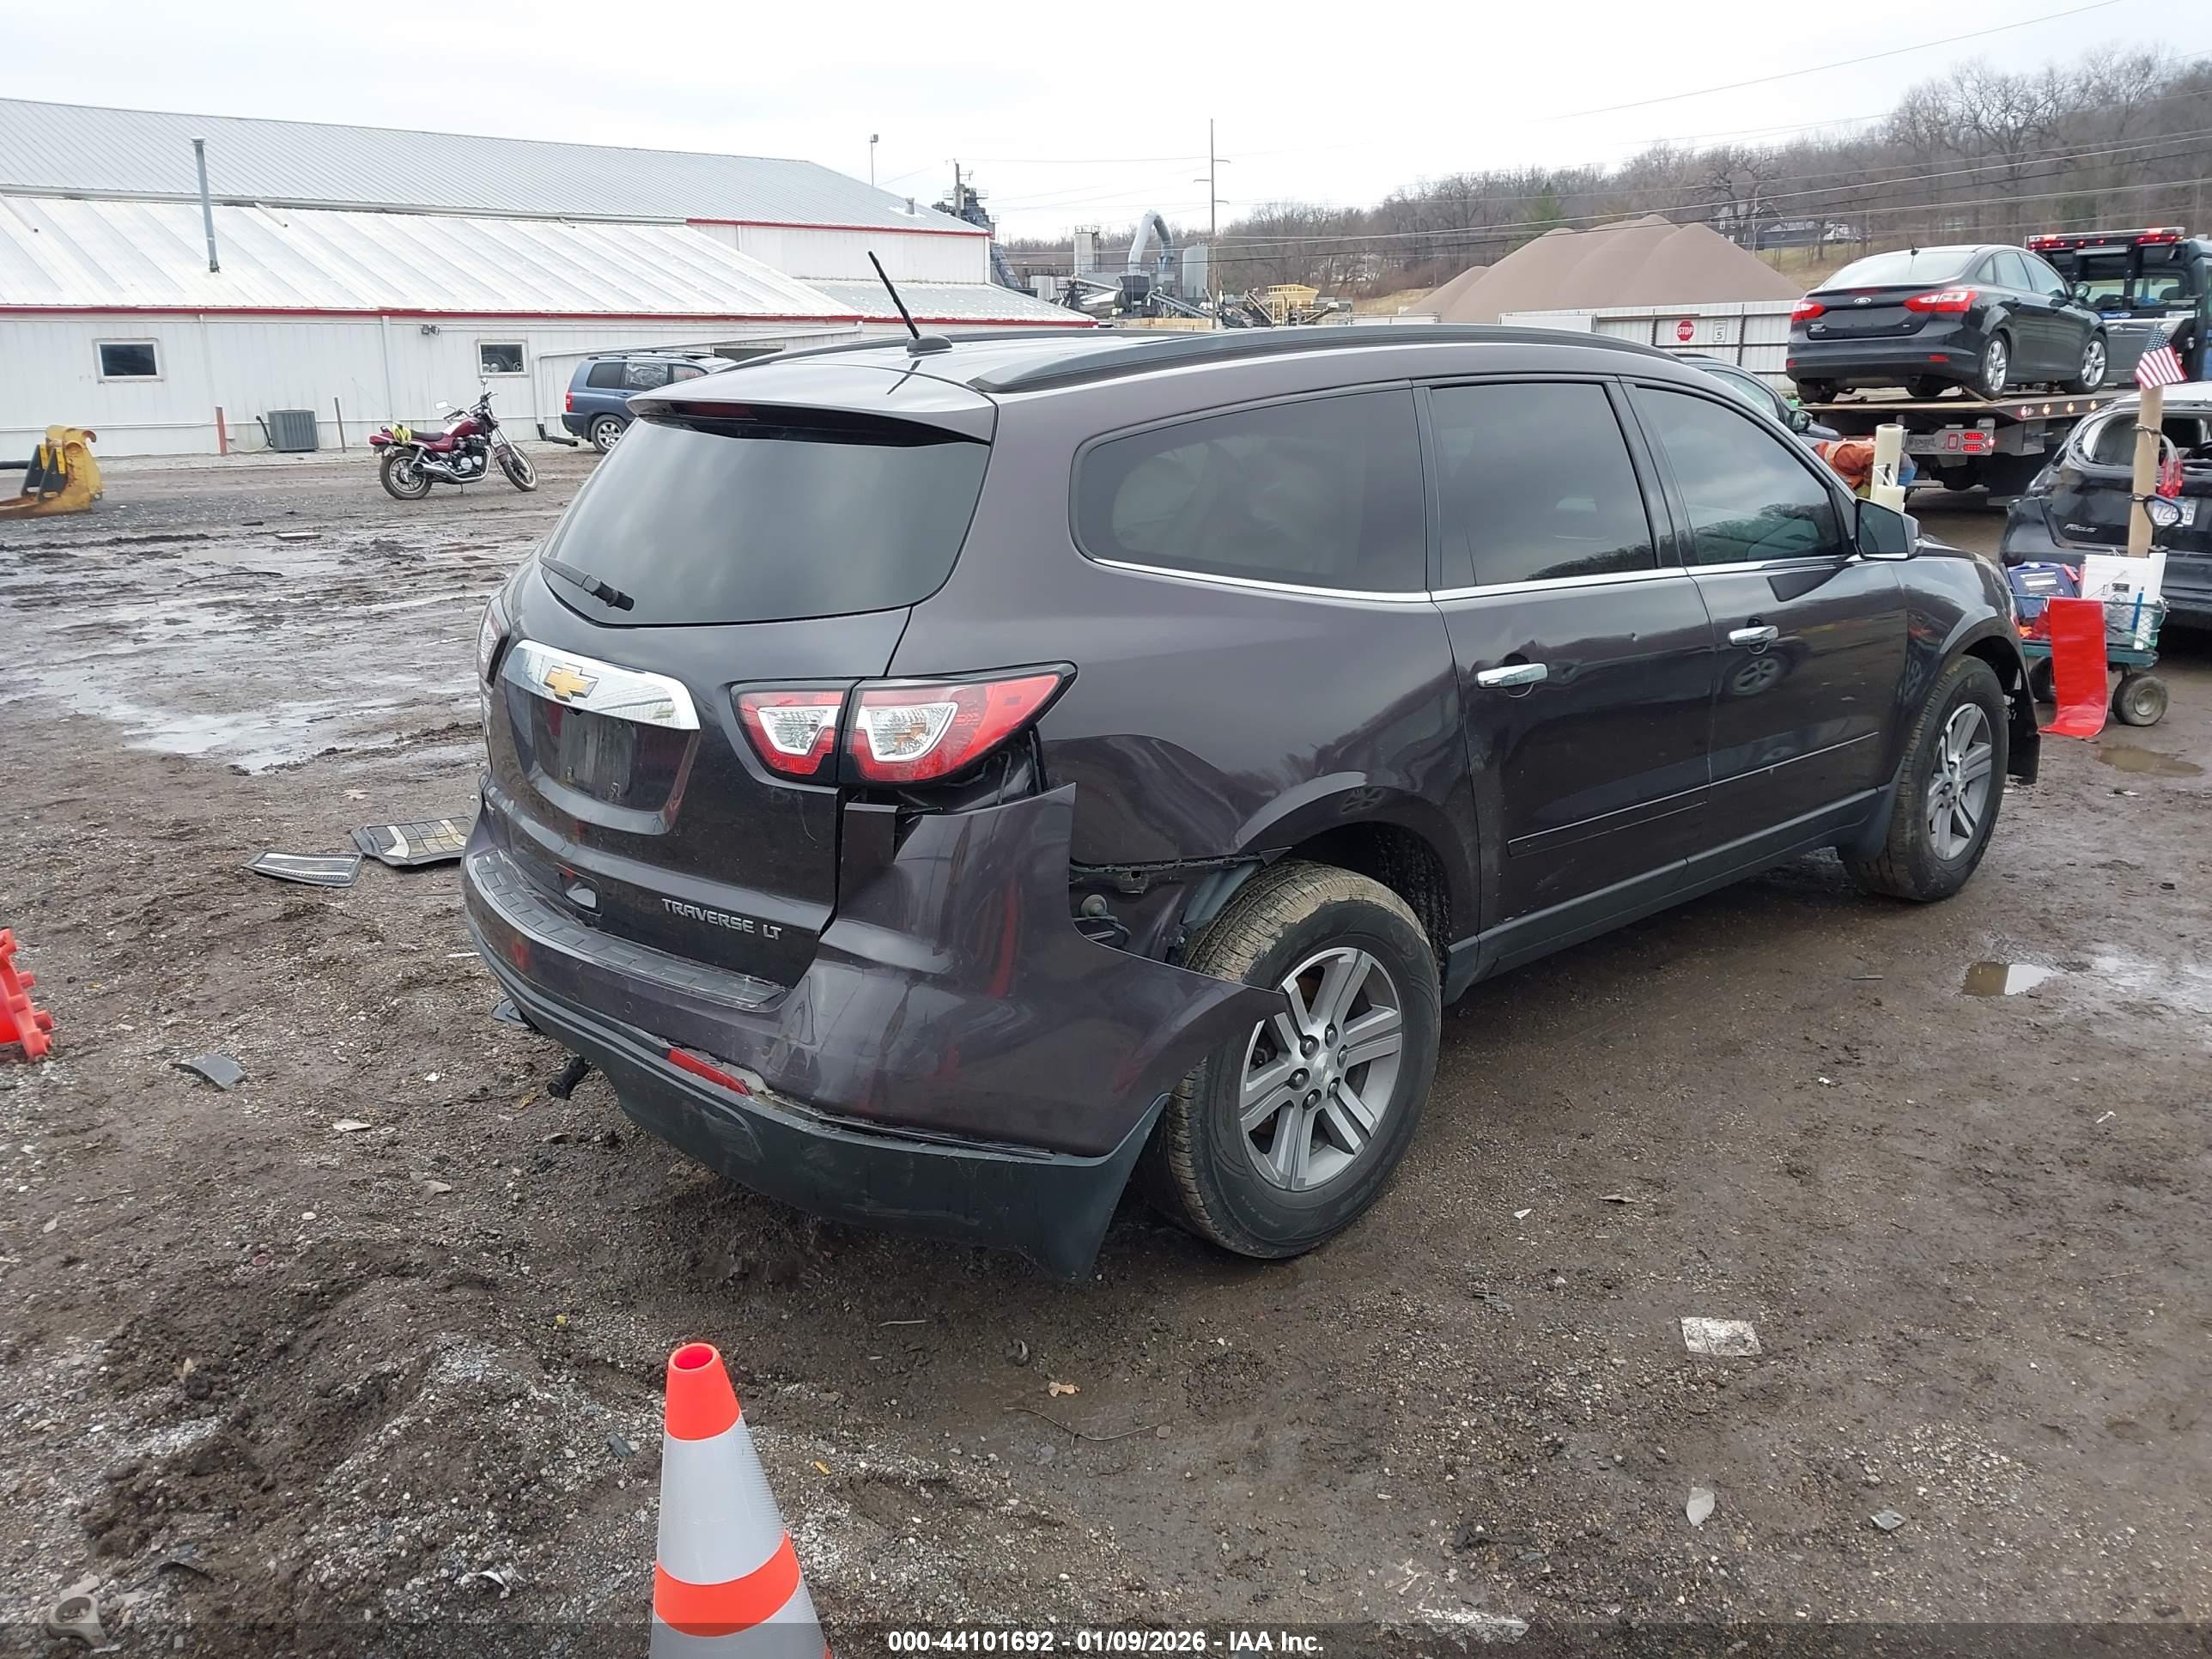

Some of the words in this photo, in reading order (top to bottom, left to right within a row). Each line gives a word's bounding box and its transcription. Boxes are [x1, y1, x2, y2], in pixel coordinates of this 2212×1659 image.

[1678, 326, 1693, 336] STOP
[661, 898, 755, 933] TRAVERSE
[763, 924, 781, 939] LT
